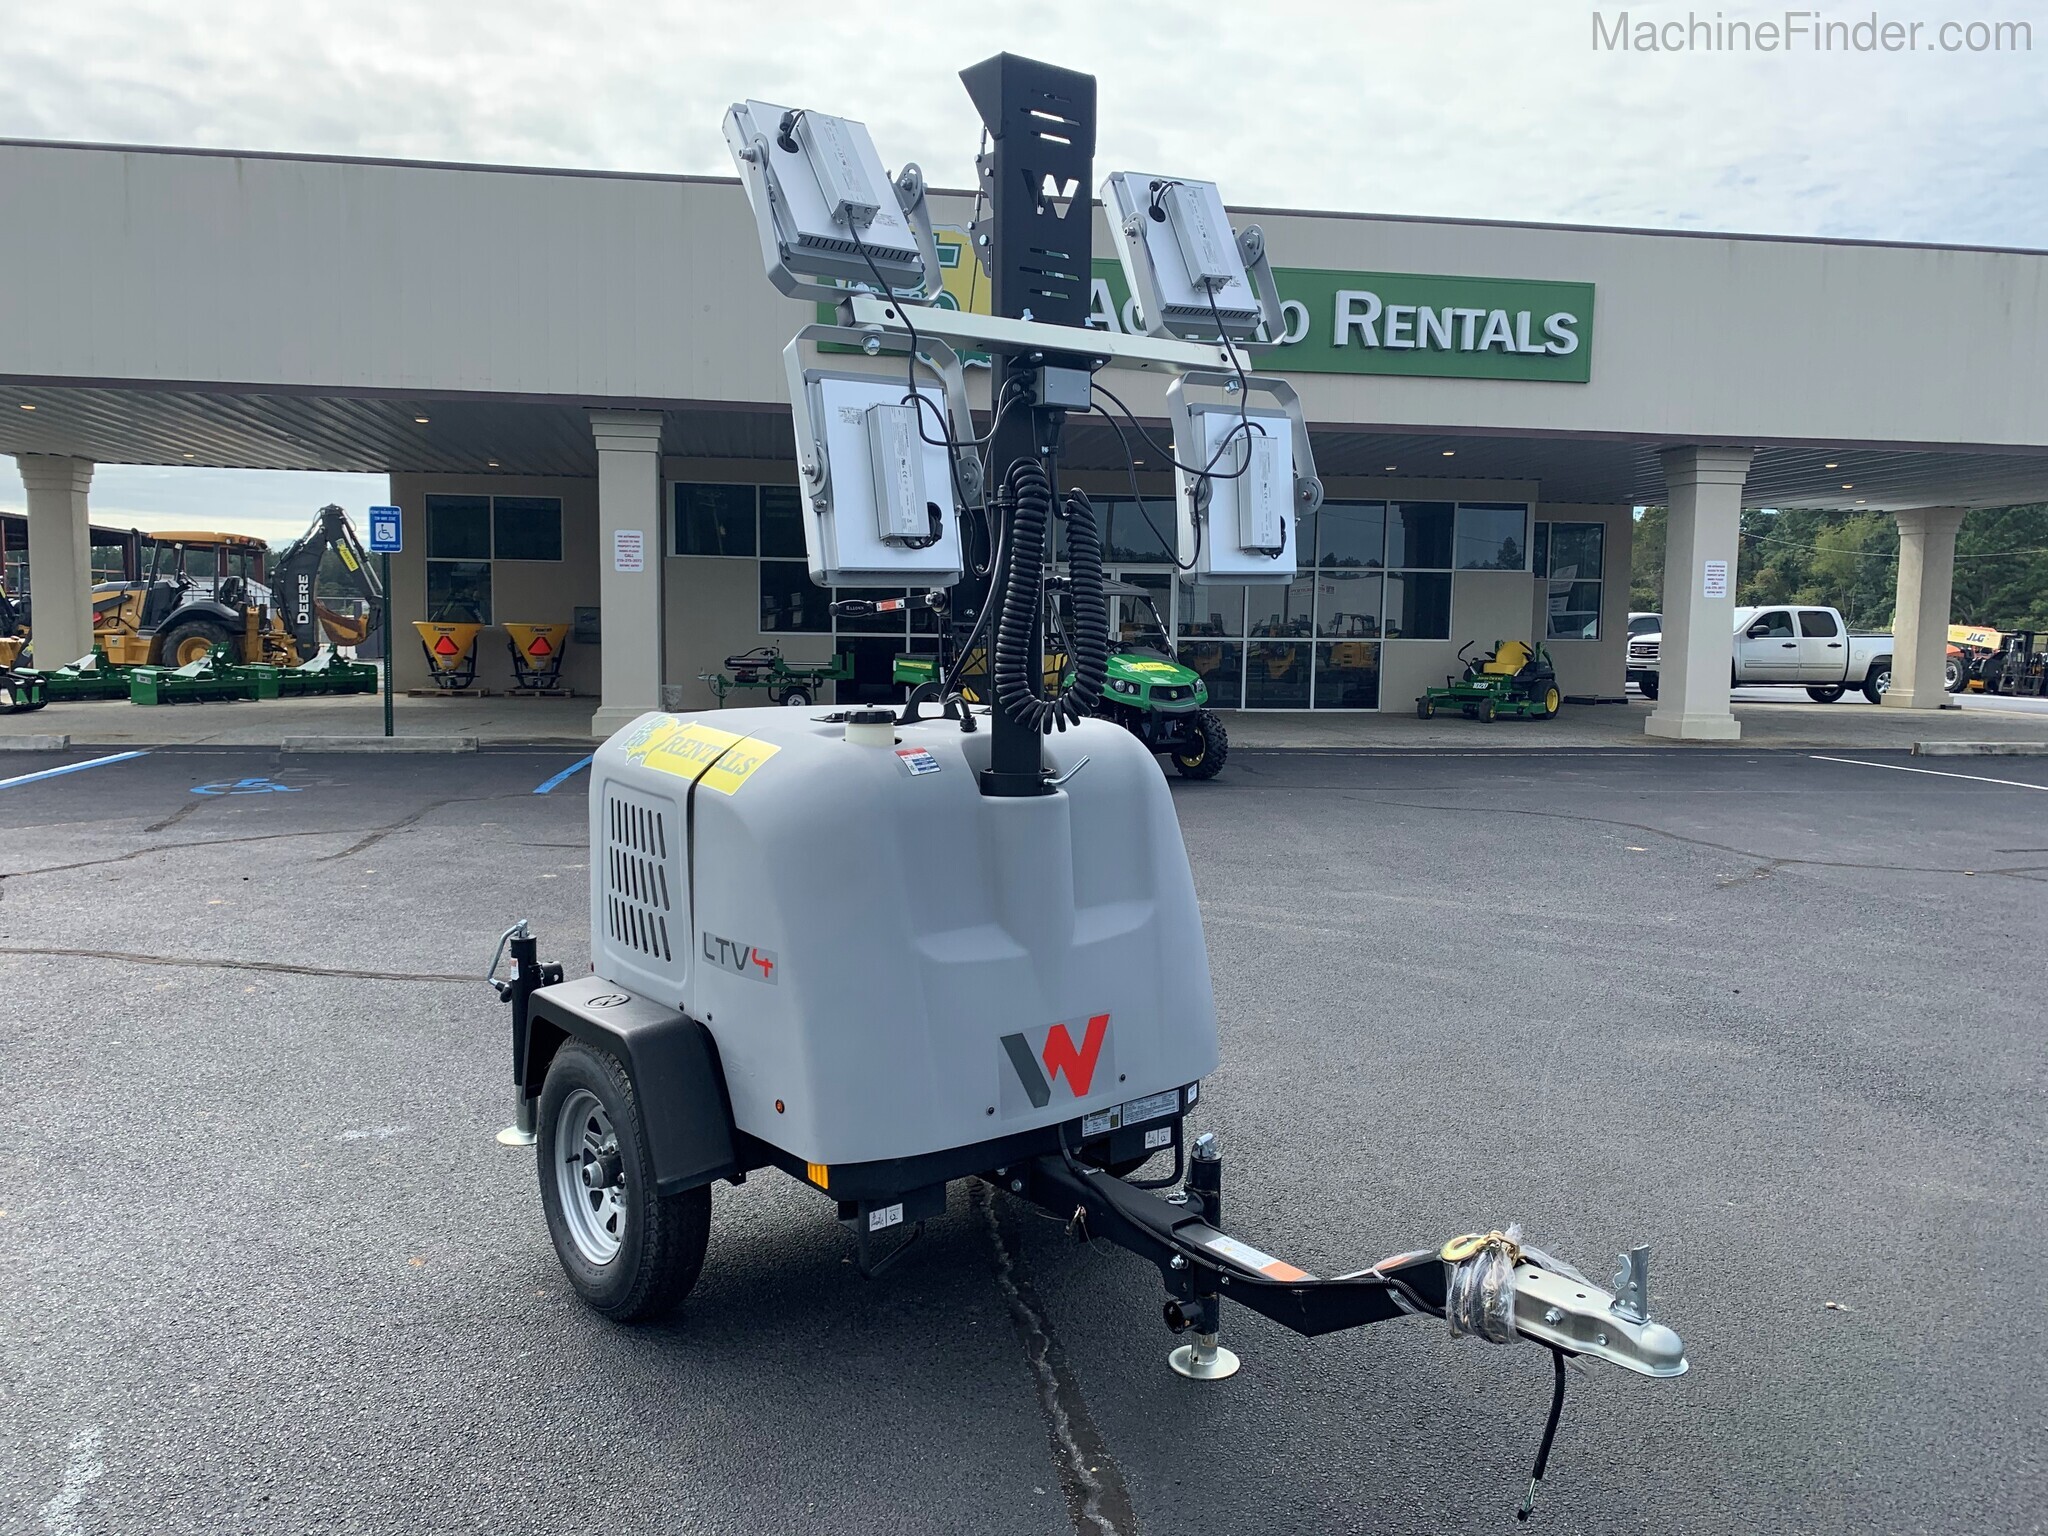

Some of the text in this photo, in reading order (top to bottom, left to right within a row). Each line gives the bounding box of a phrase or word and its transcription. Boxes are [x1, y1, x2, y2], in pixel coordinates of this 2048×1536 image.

[1333, 289, 1579, 355] RENTALS
[297, 574, 309, 624] DEERE
[1966, 632, 1986, 642] JLG
[703, 932, 773, 978] LTV4
